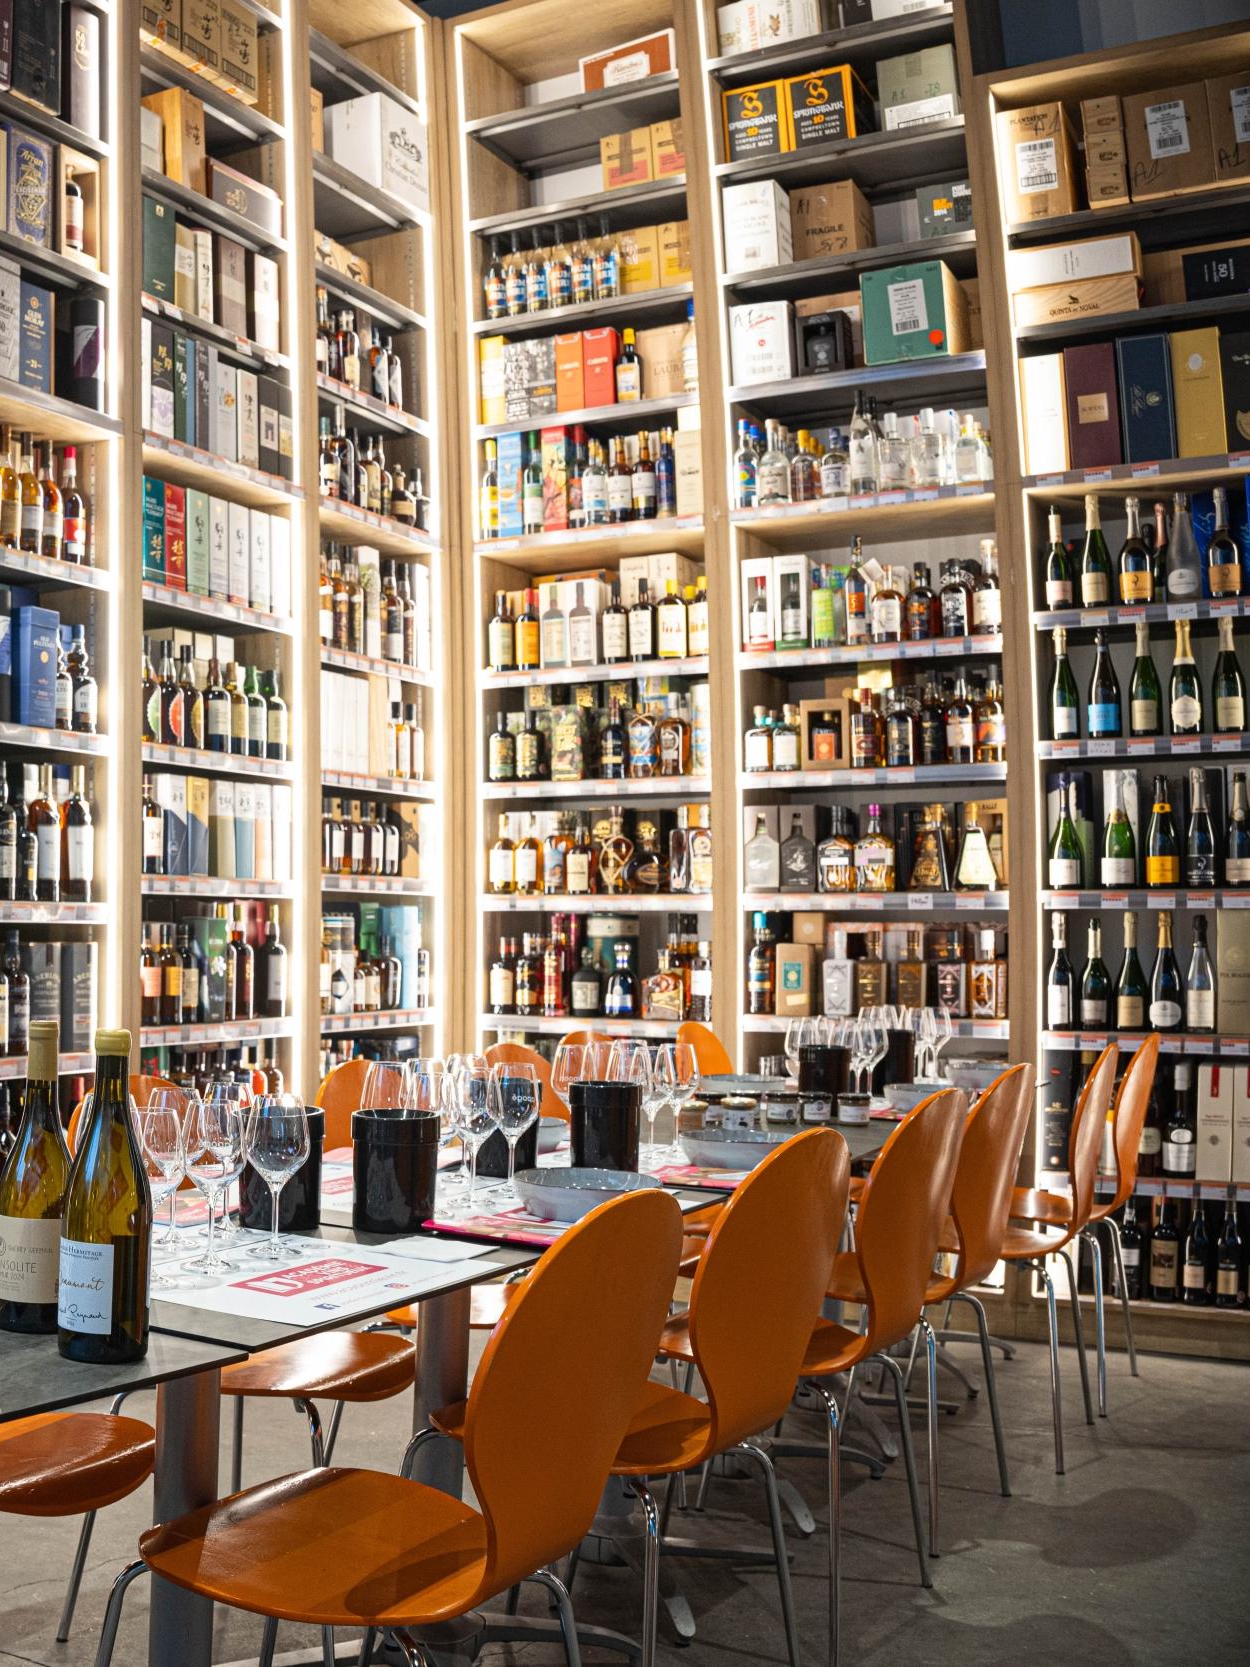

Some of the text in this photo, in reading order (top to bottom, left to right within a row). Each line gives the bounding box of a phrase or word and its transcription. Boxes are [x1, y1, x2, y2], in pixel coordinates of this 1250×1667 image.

[793, 101, 844, 118] SPRINGBANK
[728, 114, 777, 130] SPRINGBANK
[802, 127, 840, 139] SINGLE MALT
[760, 139, 773, 147] MALT
[806, 224, 844, 237] FRAGILE
[1049, 307, 1073, 317] QUINTA
[1079, 303, 1100, 314] NOVAL
[68, 1244, 103, 1257] HERMITAGE
